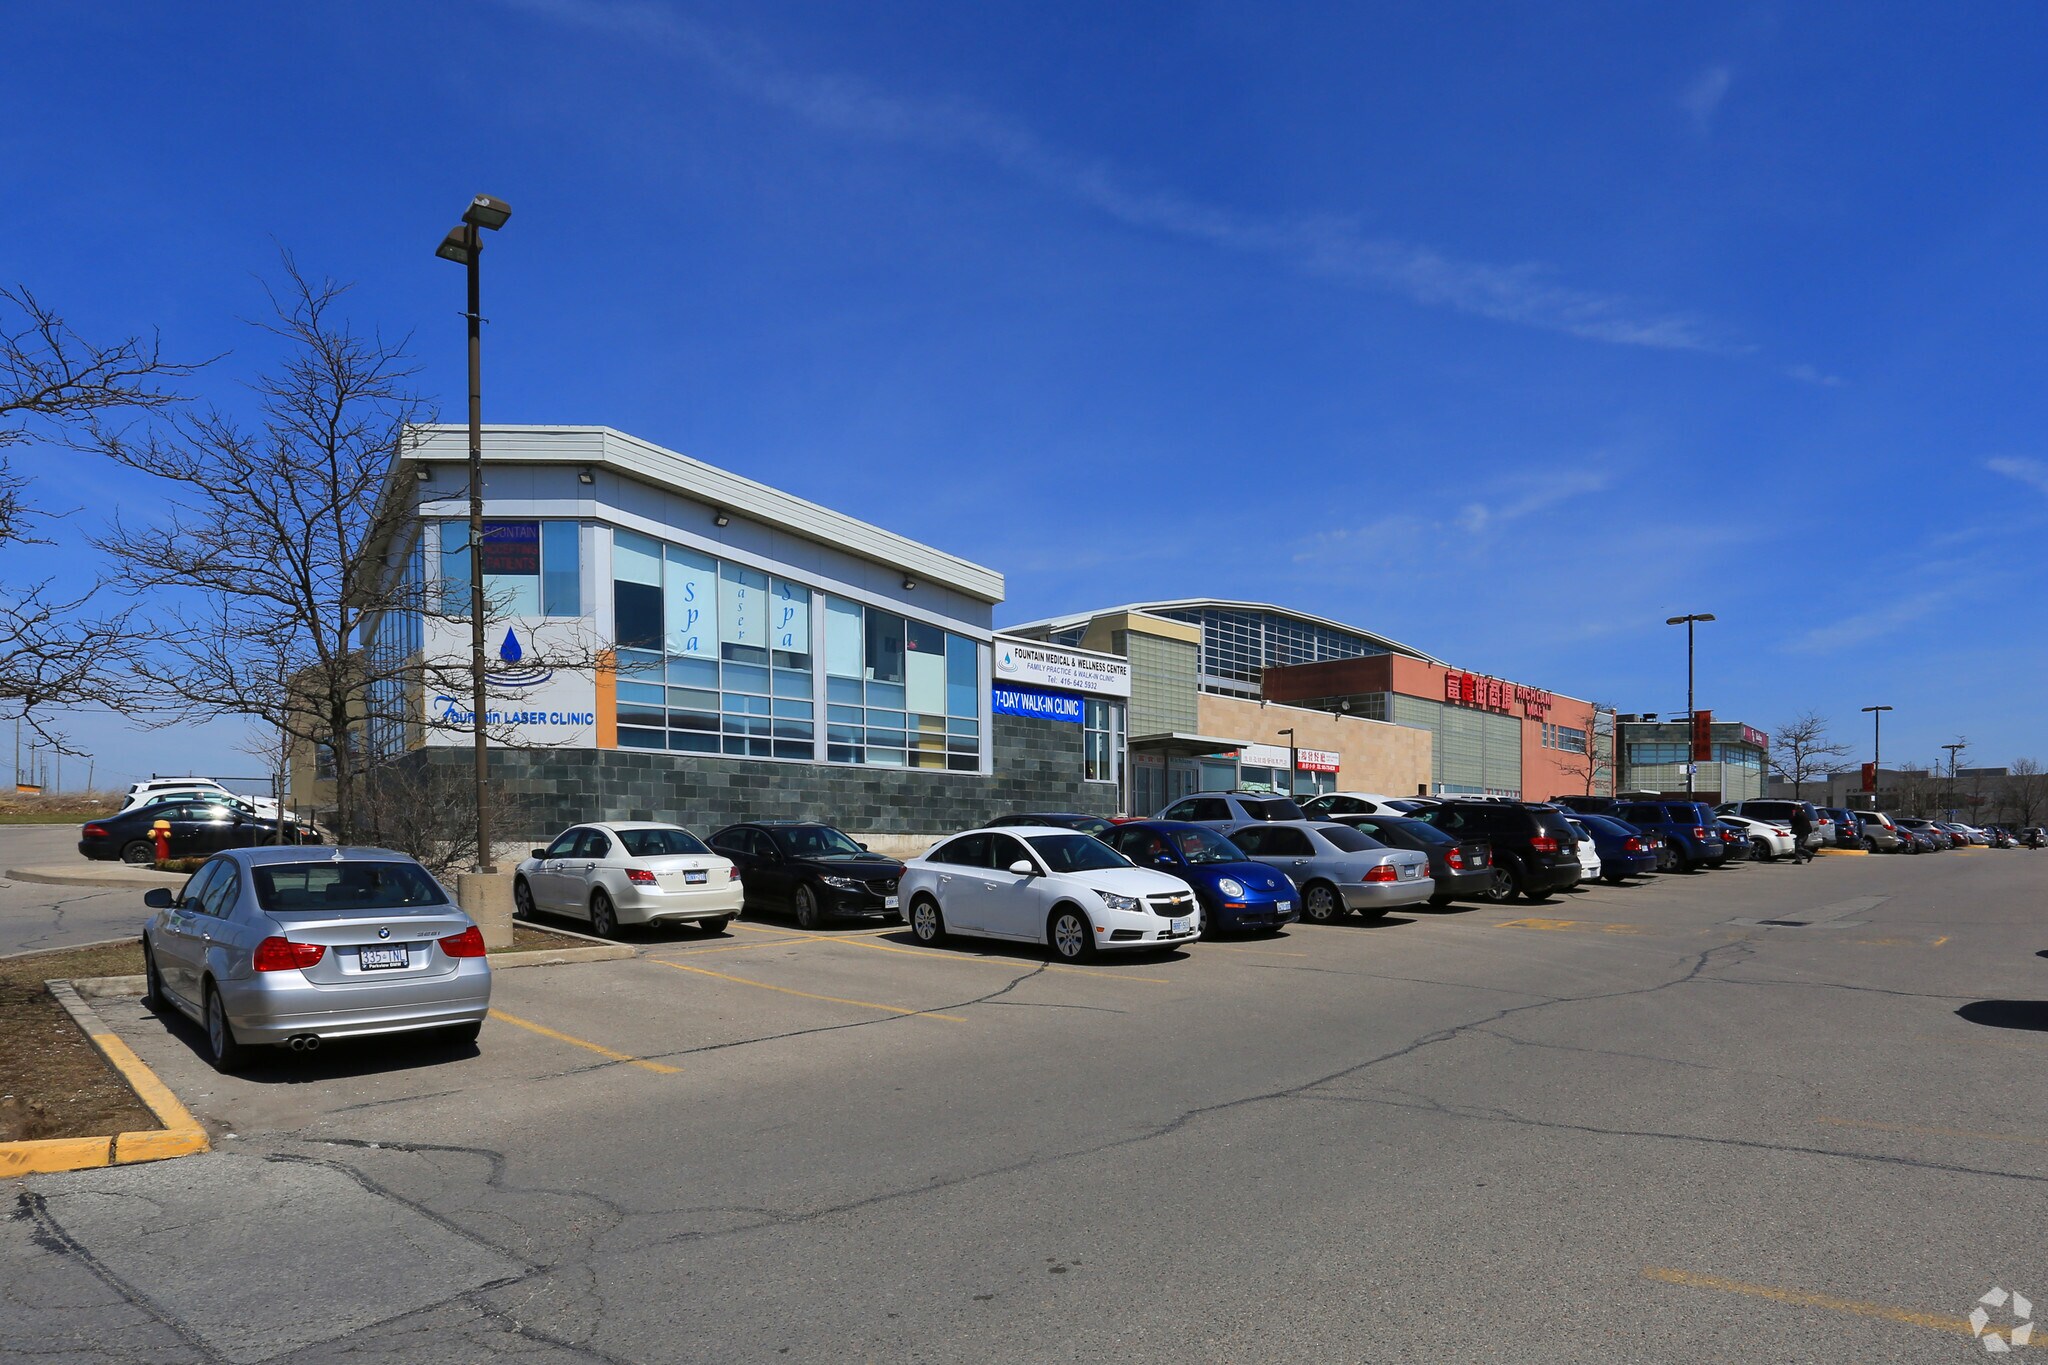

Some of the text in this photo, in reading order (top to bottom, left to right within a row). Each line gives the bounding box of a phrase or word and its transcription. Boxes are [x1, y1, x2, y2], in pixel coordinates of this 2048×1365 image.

[484, 525, 537, 538] FOUNTAIN
[680, 581, 699, 651] Spa
[776, 582, 794, 647] Spa
[1014, 647, 1127, 676] FOUNTAIN MEDICAL & WELLNESS CENTRE
[1026, 662, 1046, 671] FAMILY
[1046, 665, 1071, 676] PRACTICE
[1078, 671, 1099, 680] WALK-IN
[1099, 673, 1115, 683] CLINIC
[995, 690, 1079, 716] 7-DAY WALK-IN CLINIC
[504, 711, 547, 725] LASER
[549, 711, 594, 726] CLINIC
